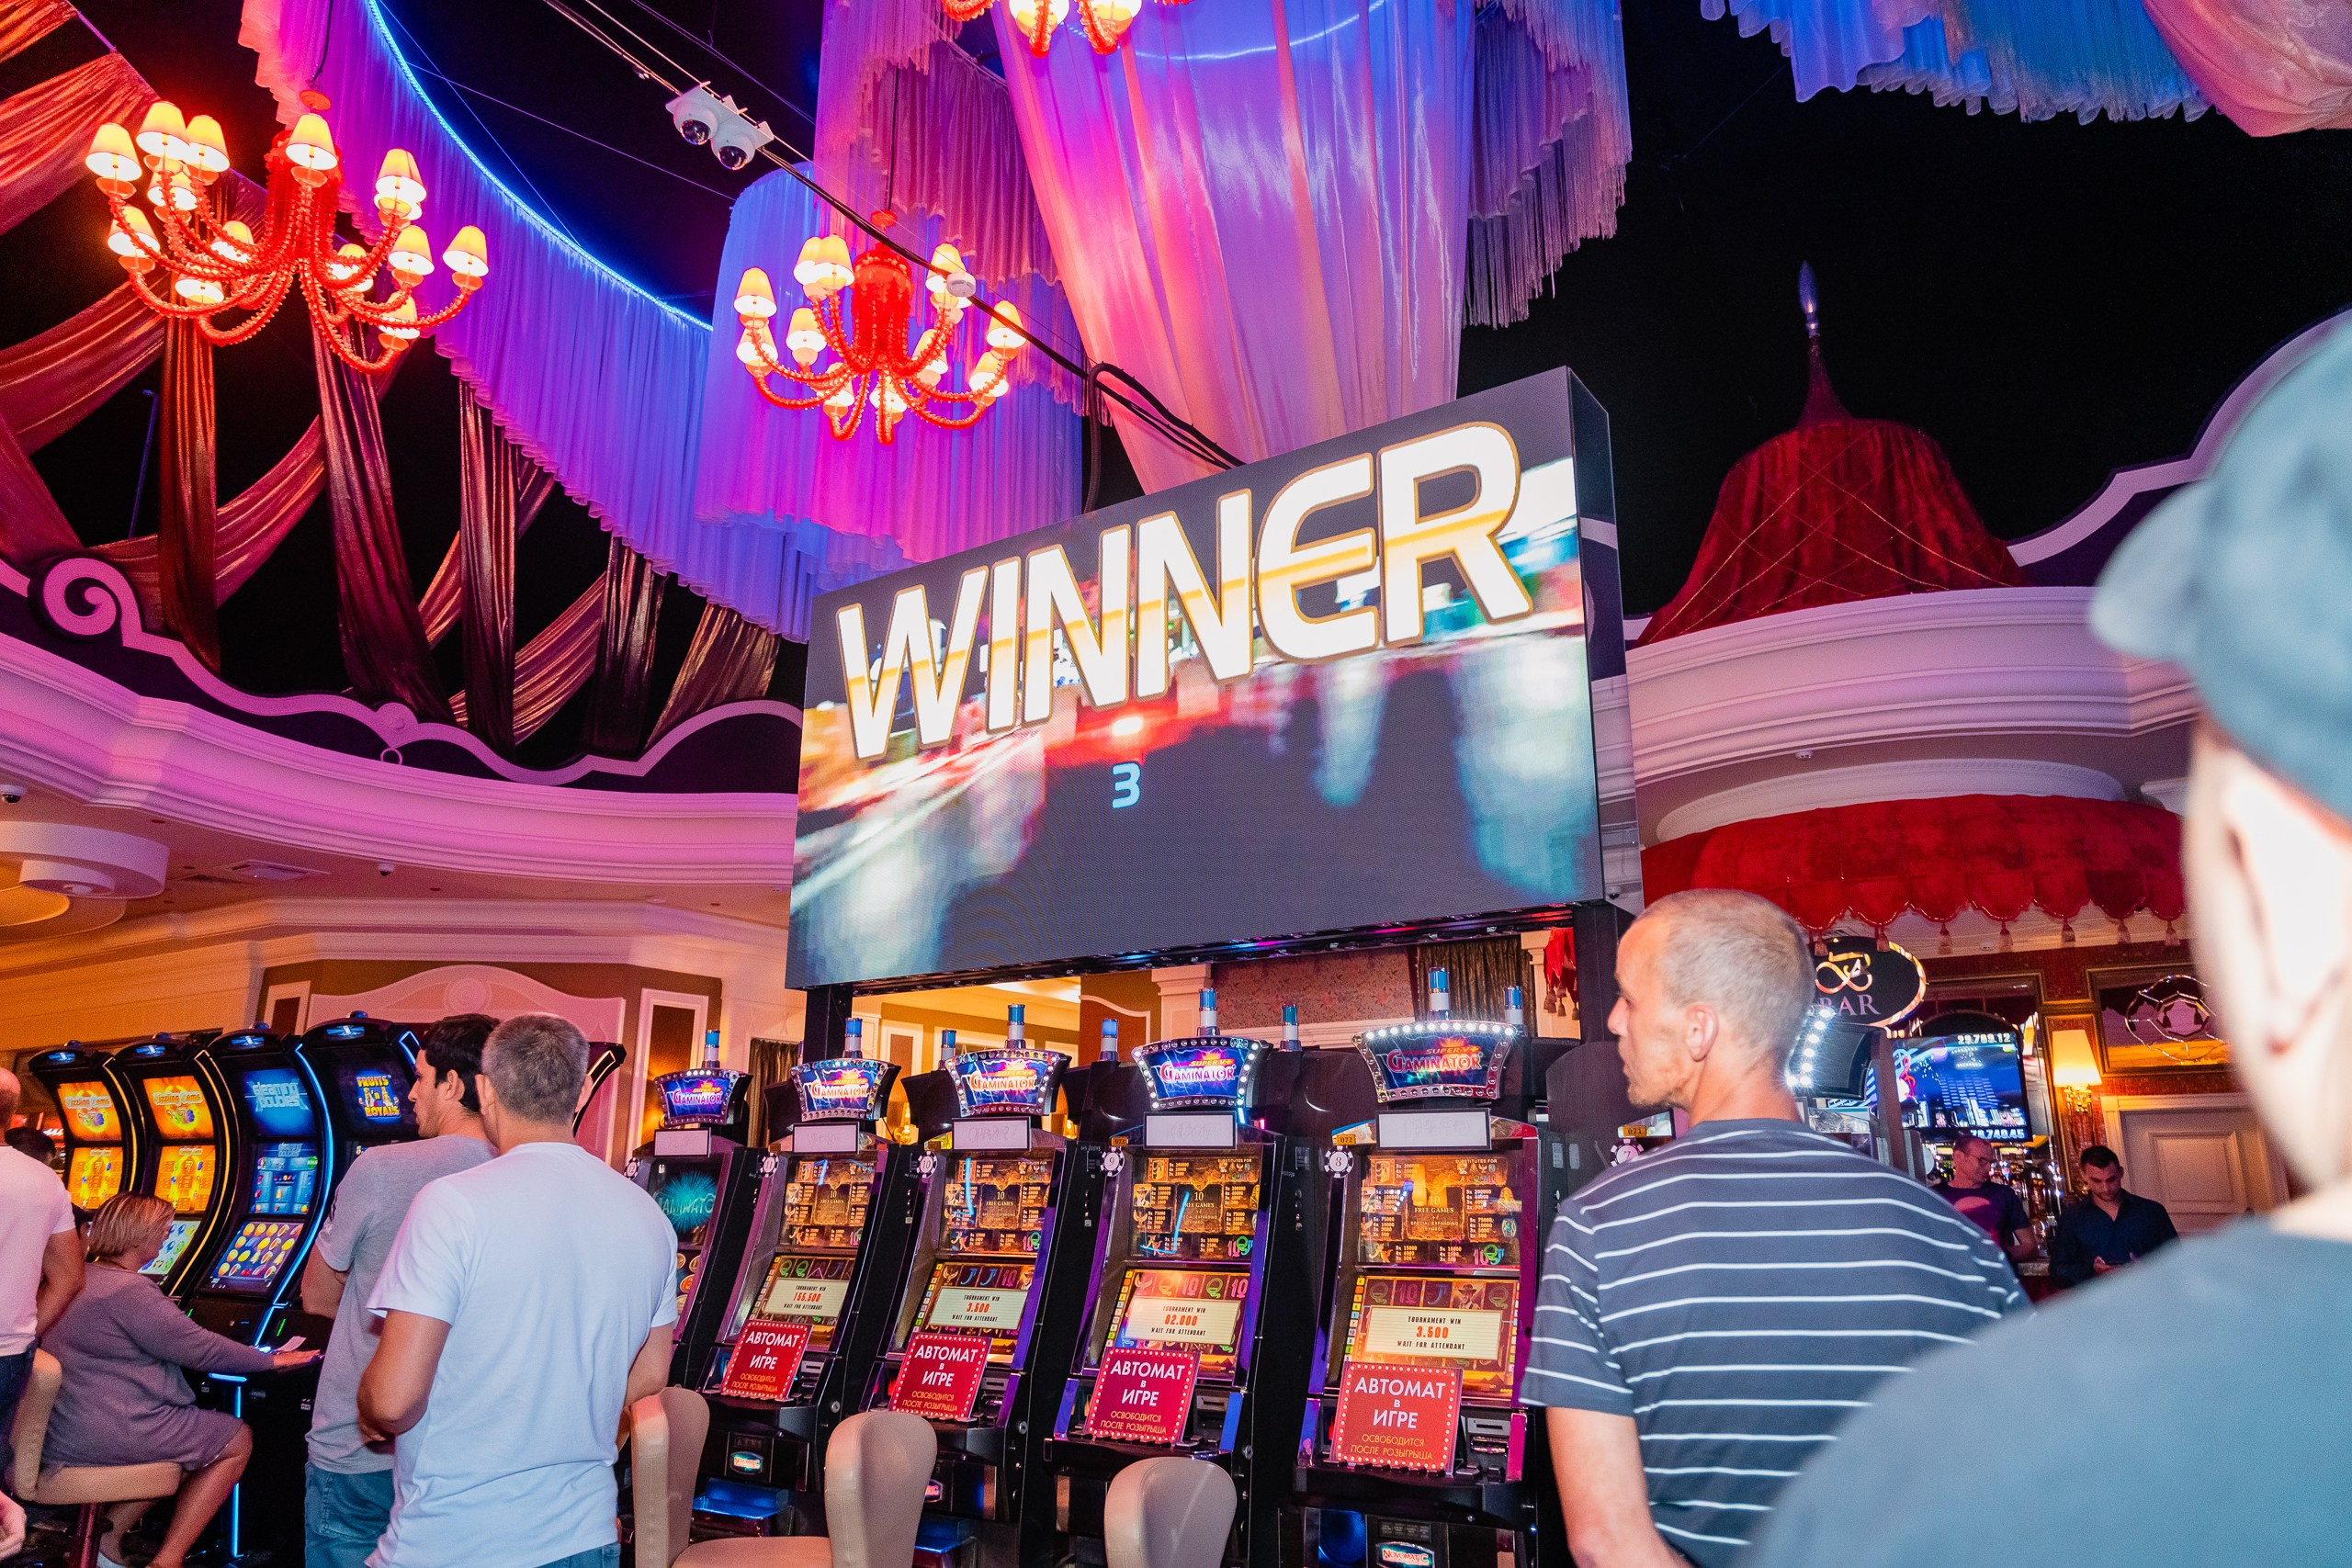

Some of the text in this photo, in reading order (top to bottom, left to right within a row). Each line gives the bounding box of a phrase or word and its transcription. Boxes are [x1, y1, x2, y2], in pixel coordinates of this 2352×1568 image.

[836, 421, 1532, 760] WINNER
[1112, 762, 1141, 808] 3
[1387, 1049, 1483, 1073] GAMINATOR
[970, 1070, 1036, 1091] GAMINATOR
[1160, 1063, 1237, 1082] GAMINATOR
[812, 1083, 868, 1099] GAMINATOR
[997, 1191, 1005, 1200] 10
[1194, 1192, 1204, 1201] 10
[1430, 1195, 1441, 1205] 10
[967, 1302, 989, 1313] 3.500
[1408, 1316, 1447, 1325] TOURNAMENT
[745, 1331, 800, 1348] АВТОМАТ
[1416, 1325, 1449, 1338] 3.500
[914, 1345, 978, 1362] АВТОМАТ
[749, 1355, 778, 1370] ИГРЕ
[1110, 1359, 1185, 1380] АВТОМАТ
[922, 1371, 955, 1387] ИГРЕ
[1354, 1377, 1446, 1399] АВТОМАТ
[911, 1391, 955, 1402] ОСВОБОДИТСЯ
[1121, 1389, 1159, 1406] ИГРЕ
[902, 1399, 957, 1412] ПОСЛЕ РОЗЫГРЫША
[1111, 1410, 1161, 1423] ОСВОБОДИТСЯ
[1373, 1409, 1419, 1429] ИГРЕ
[1101, 1420, 1167, 1434] ПОСЛЕ РОЗЫГРЫША
[1362, 1434, 1424, 1447] ОСВОБОДИТСЯ
[1351, 1445, 1432, 1461] ПОСЛЕ РОЗЫГРЫША
[1382, 1549, 1430, 1566] NOVOMATIC
